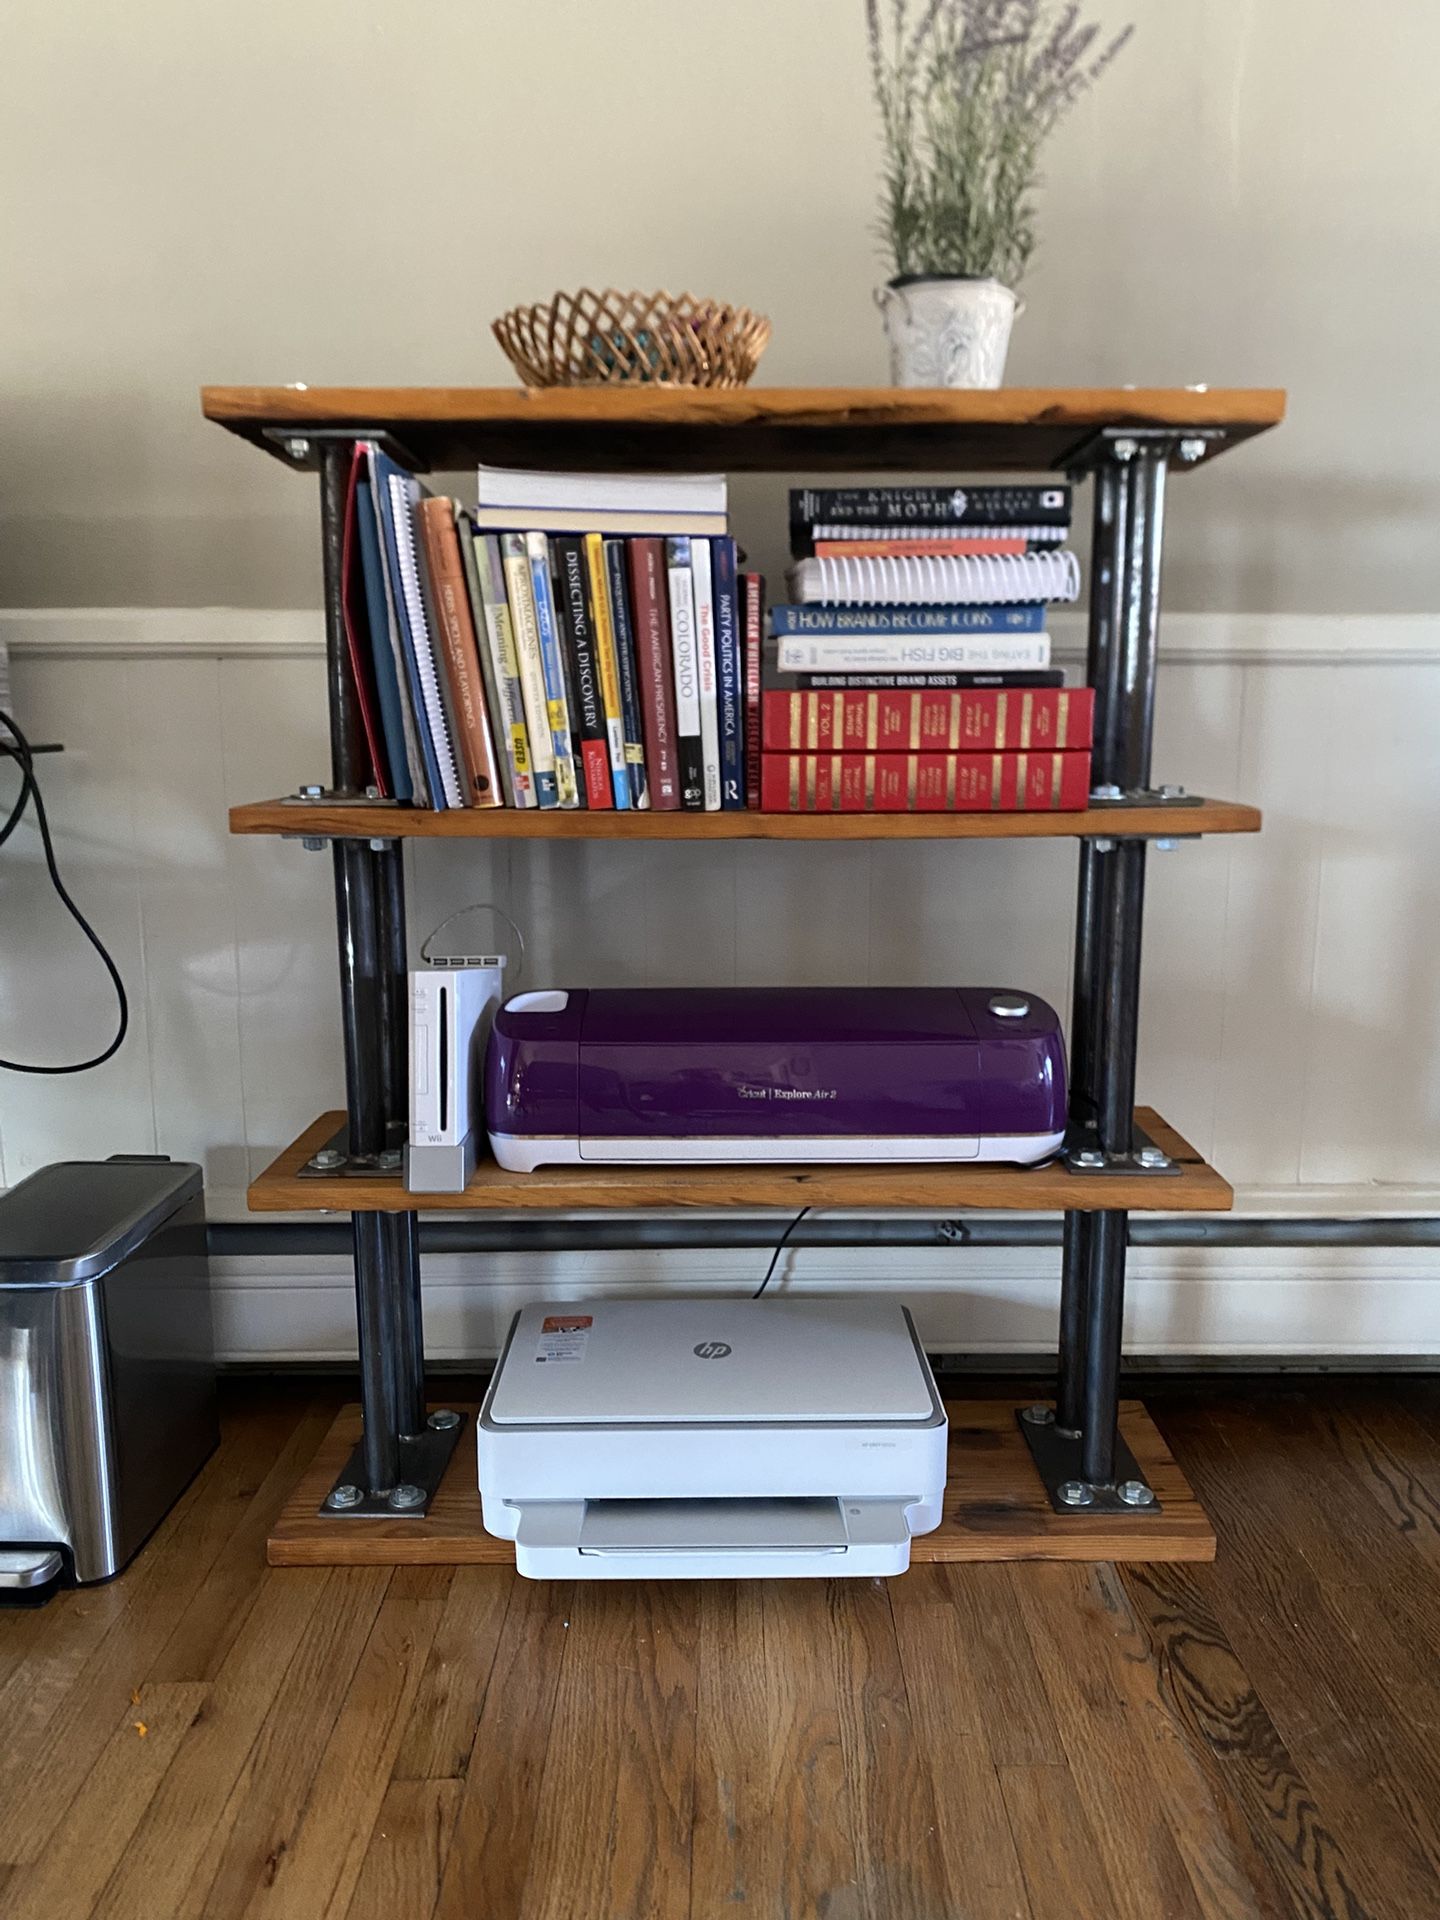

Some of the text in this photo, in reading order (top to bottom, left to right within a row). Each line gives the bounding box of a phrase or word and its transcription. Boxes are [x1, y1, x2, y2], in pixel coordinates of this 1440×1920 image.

[868, 490, 938, 502] KNIGHT
[887, 502, 947, 517] MOTH
[518, 564, 538, 661] APROXIMACIONES
[648, 608, 659, 626] THE
[719, 594, 731, 627] PARTY
[747, 581, 759, 638] AMERICAN
[799, 611, 834, 629] HOW
[836, 610, 890, 628] BRANDS
[892, 609, 946, 626] BECOME
[951, 609, 993, 626] ICONS
[494, 612, 508, 665] Meaning
[566, 551, 598, 729] DISSECTING A DISCOVERY
[619, 622, 627, 638] AND
[444, 584, 475, 729] HERBS SPICES AND FLAVORINGS
[651, 629, 664, 683] AMERICAN
[676, 609, 694, 698] COLORADO
[700, 603, 713, 692] The Good Crisis
[722, 630, 733, 673] POLITICS
[901, 647, 936, 661] FISH
[938, 647, 965, 661] BIG
[966, 647, 988, 659] THE
[620, 640, 633, 704] STRATIFICATION
[724, 676, 733, 688] IN
[747, 642, 759, 703] WHITELASH
[811, 675, 958, 687] BUILDING DISTINCTIVE BRAND ASSETS
[654, 684, 667, 744] PRESIDENCY
[724, 690, 735, 736] AMERICA
[821, 703, 831, 736] VOL. 2
[846, 705, 855, 736] SENATE
[514, 737, 526, 765] USED
[774, 1088, 812, 1100] Explore
[814, 1089, 829, 1099] Air
[428, 1135, 443, 1143] Wii
[700, 1343, 728, 1360] hp
